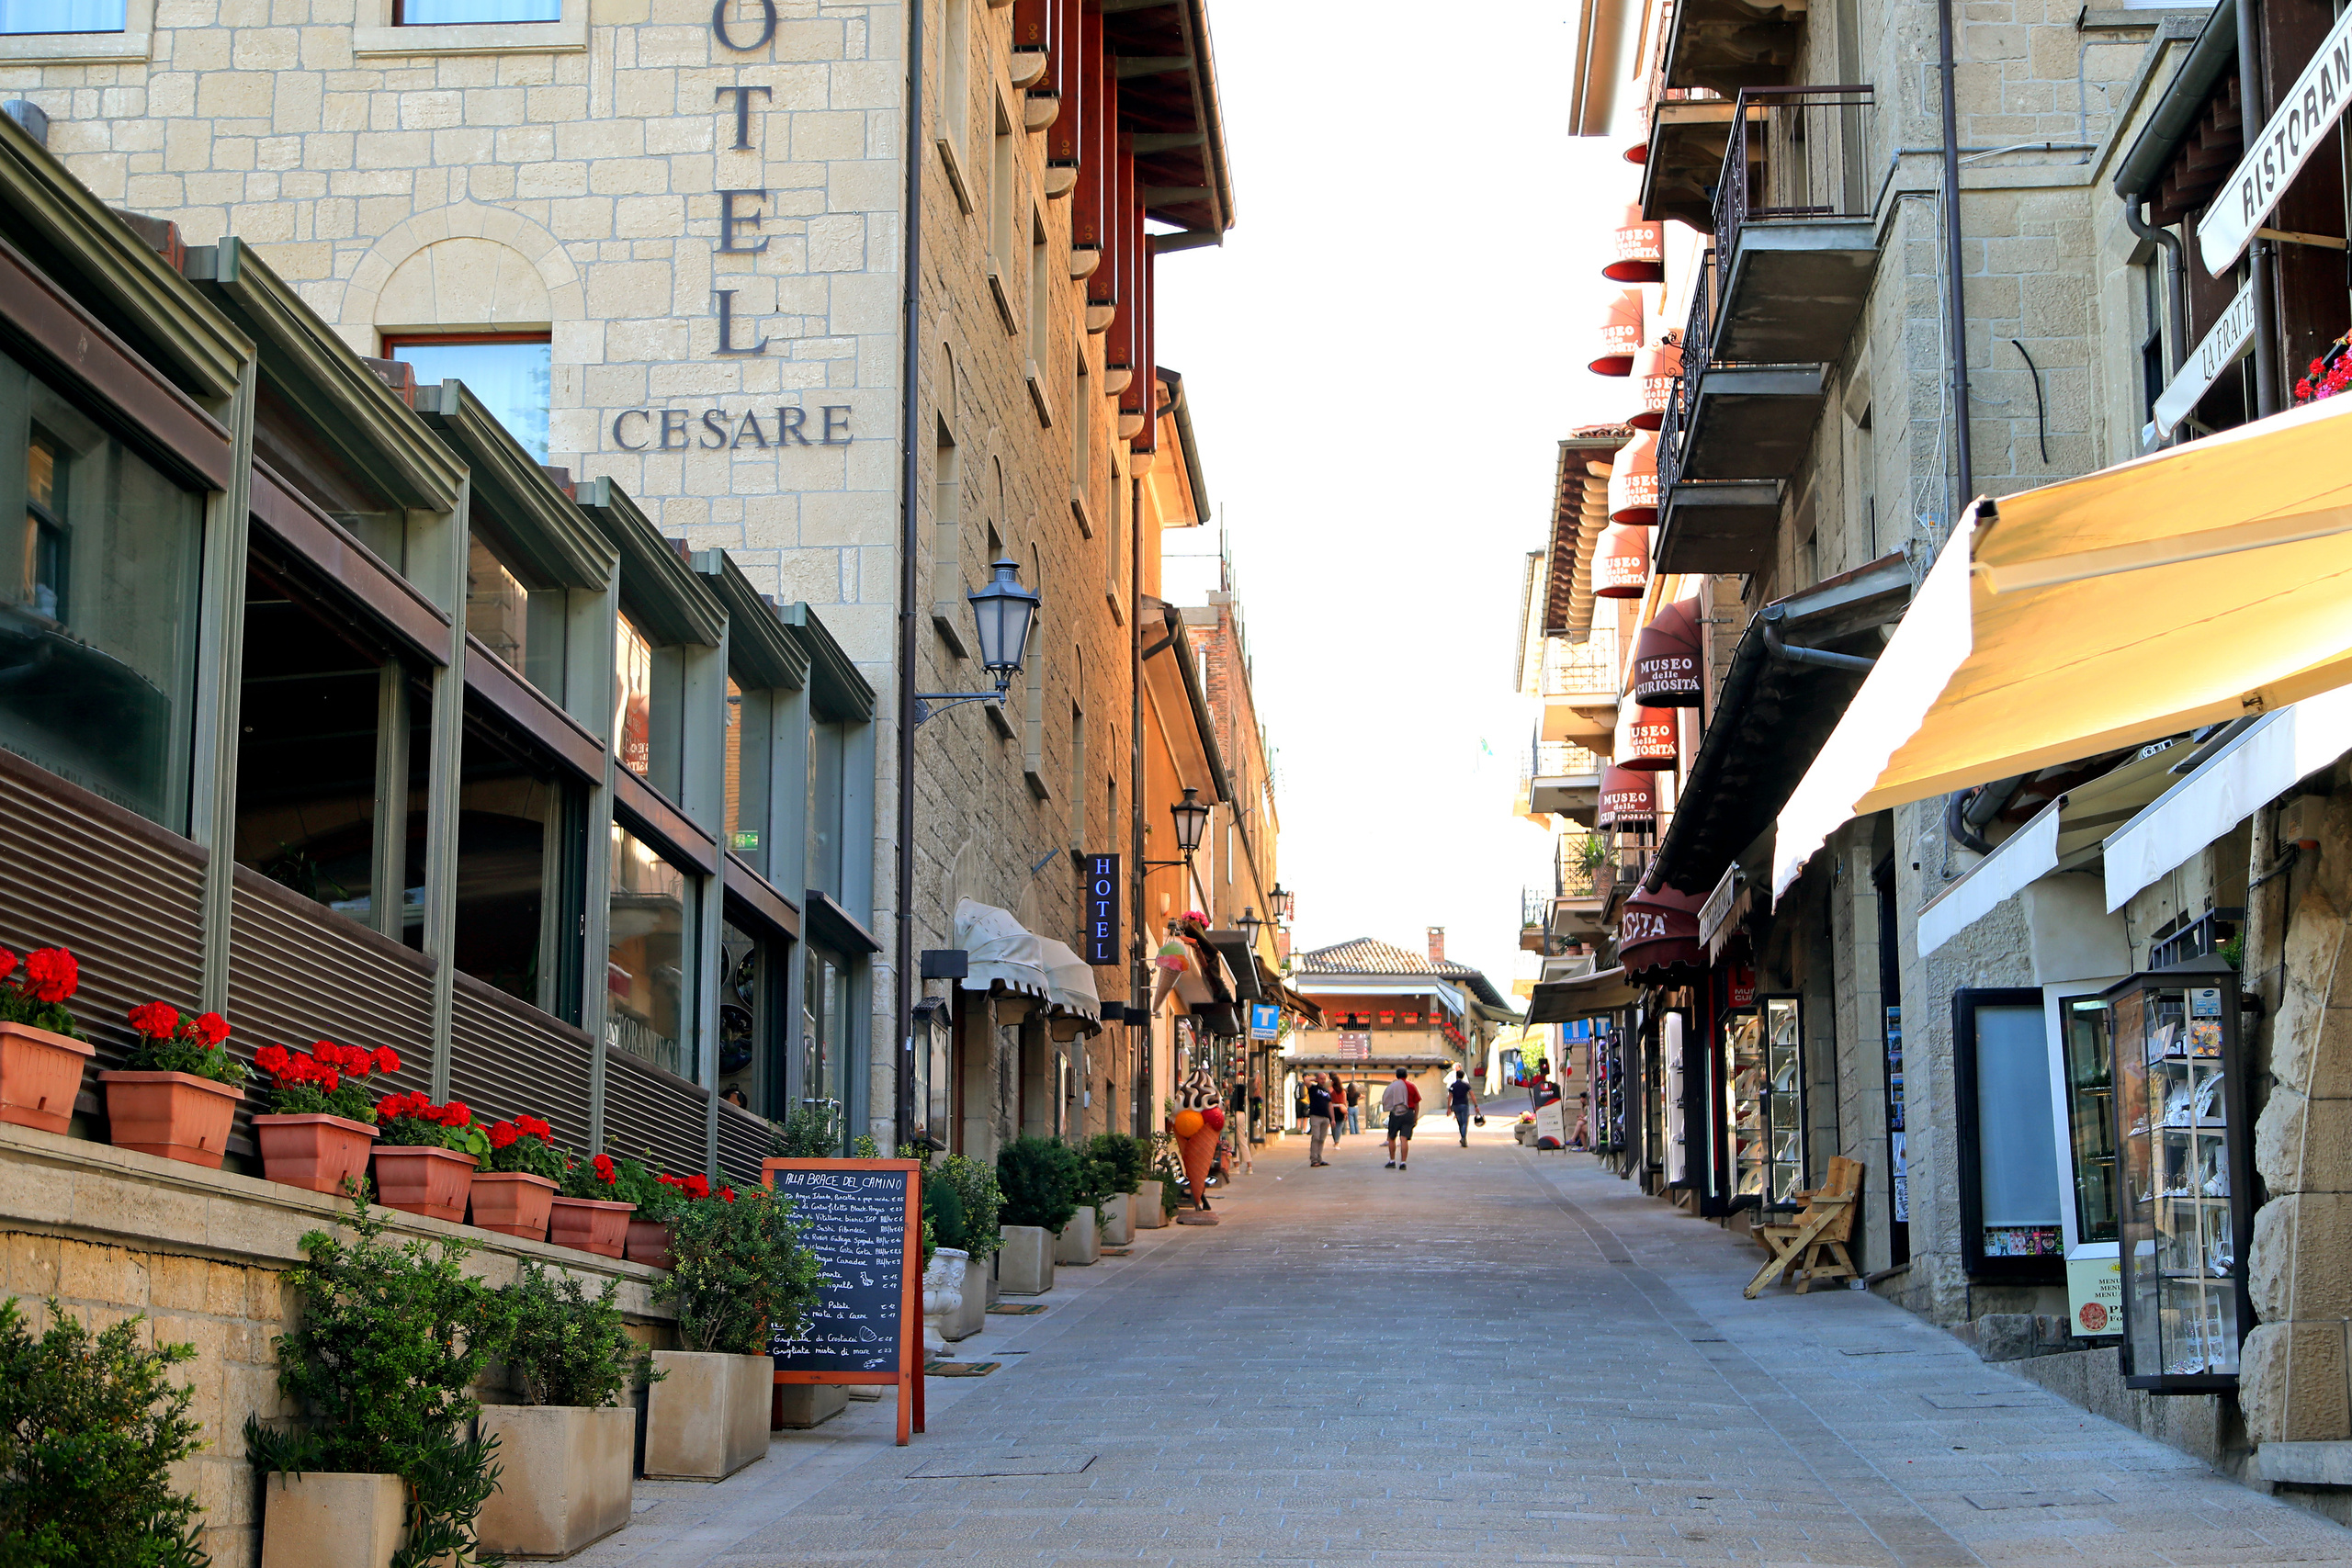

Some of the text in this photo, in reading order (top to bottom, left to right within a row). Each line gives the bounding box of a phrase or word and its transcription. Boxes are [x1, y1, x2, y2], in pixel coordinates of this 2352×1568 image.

[2242, 27, 2352, 228] RISTORAN
[1617, 229, 1654, 242] USEO
[2202, 343, 2215, 381] LA
[612, 404, 855, 451] CESARE
[1607, 557, 1641, 569] USEO
[1640, 658, 1692, 673] MUSEO
[1652, 671, 1679, 680] delle
[1631, 725, 1670, 738] USEO
[1633, 738, 1657, 746] delle
[1603, 792, 1647, 806] MUSEO
[1095, 857, 1112, 960] HOTEL
[1258, 1007, 1274, 1026] T
[605, 1012, 665, 1066] ISTORANTE
[786, 1173, 902, 1190] ALLA BRACE DEL CAMINO
